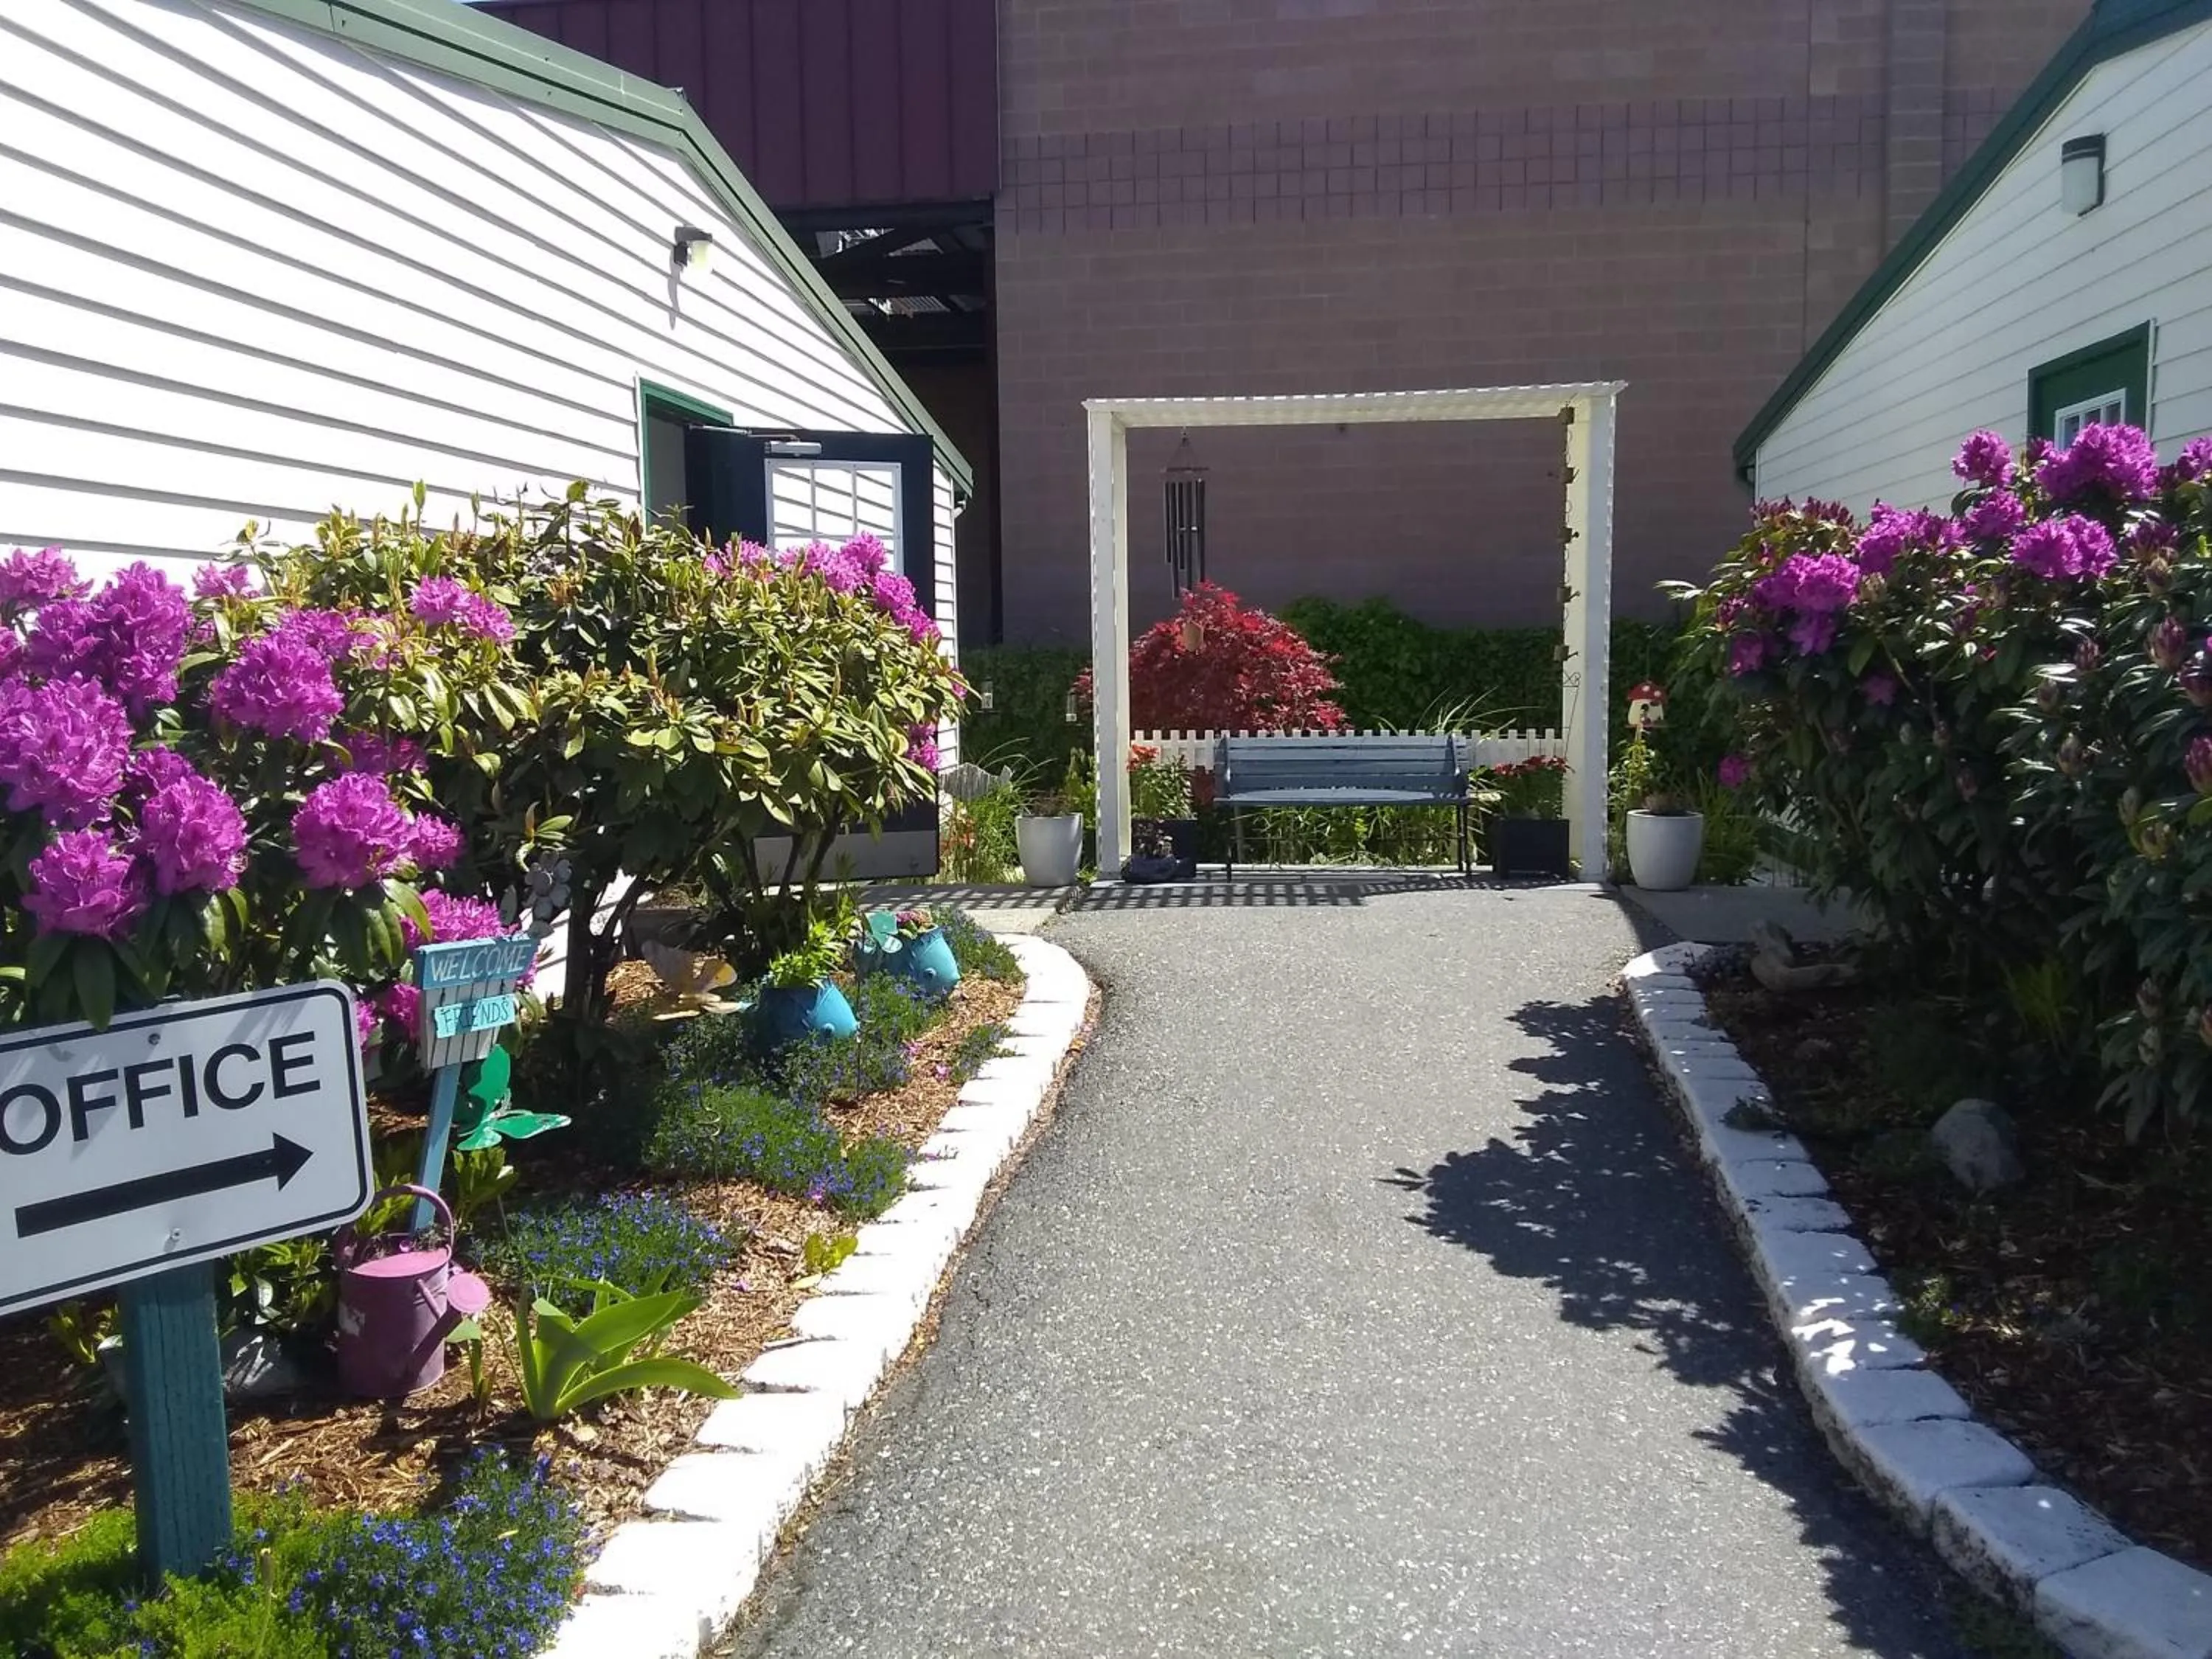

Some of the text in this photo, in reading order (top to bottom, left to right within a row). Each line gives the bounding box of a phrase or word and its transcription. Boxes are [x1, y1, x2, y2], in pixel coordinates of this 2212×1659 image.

[432, 944, 532, 981] WELCOME
[440, 1001, 509, 1033] FRIENDS
[0, 1031, 321, 1155] OFFICE
